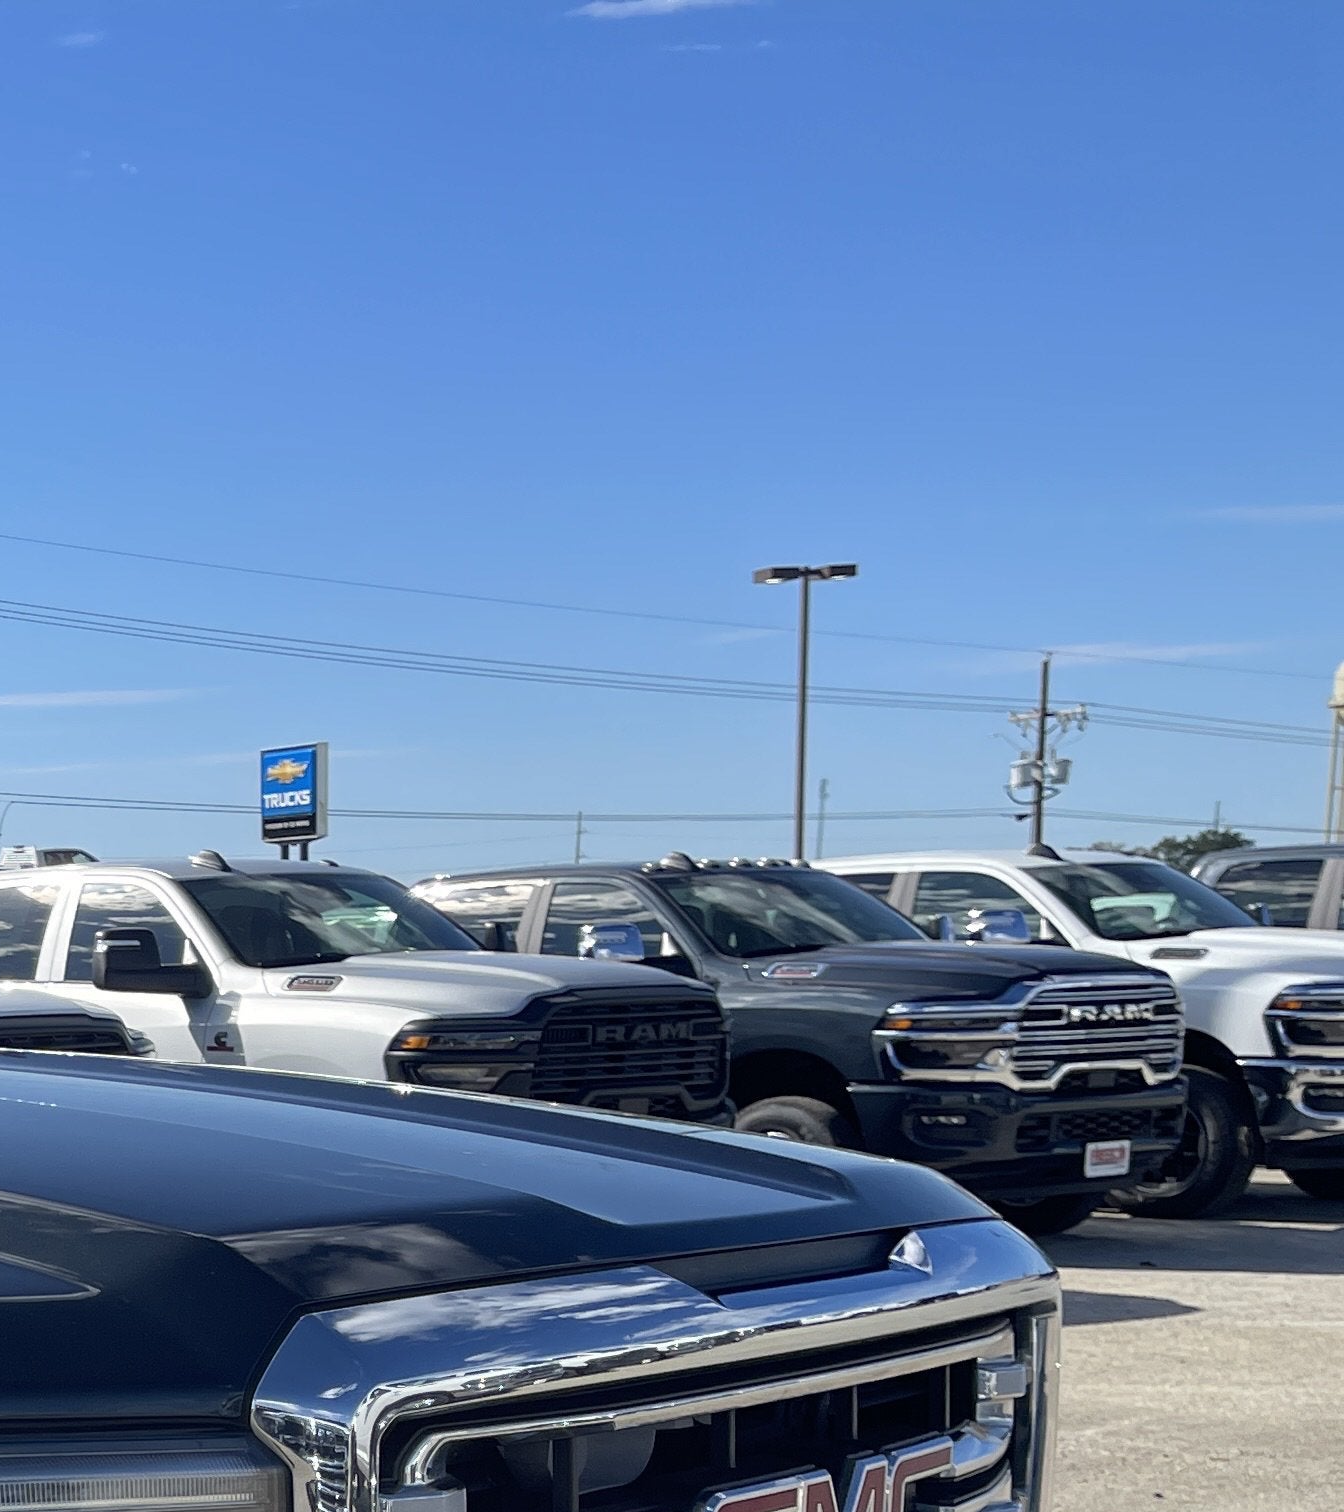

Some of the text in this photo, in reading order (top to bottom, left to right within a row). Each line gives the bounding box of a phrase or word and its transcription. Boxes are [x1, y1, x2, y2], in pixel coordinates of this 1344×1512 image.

[263, 790, 311, 809] TRUCKS
[1070, 1003, 1154, 1022] RAM
[595, 1021, 690, 1043] RAM
